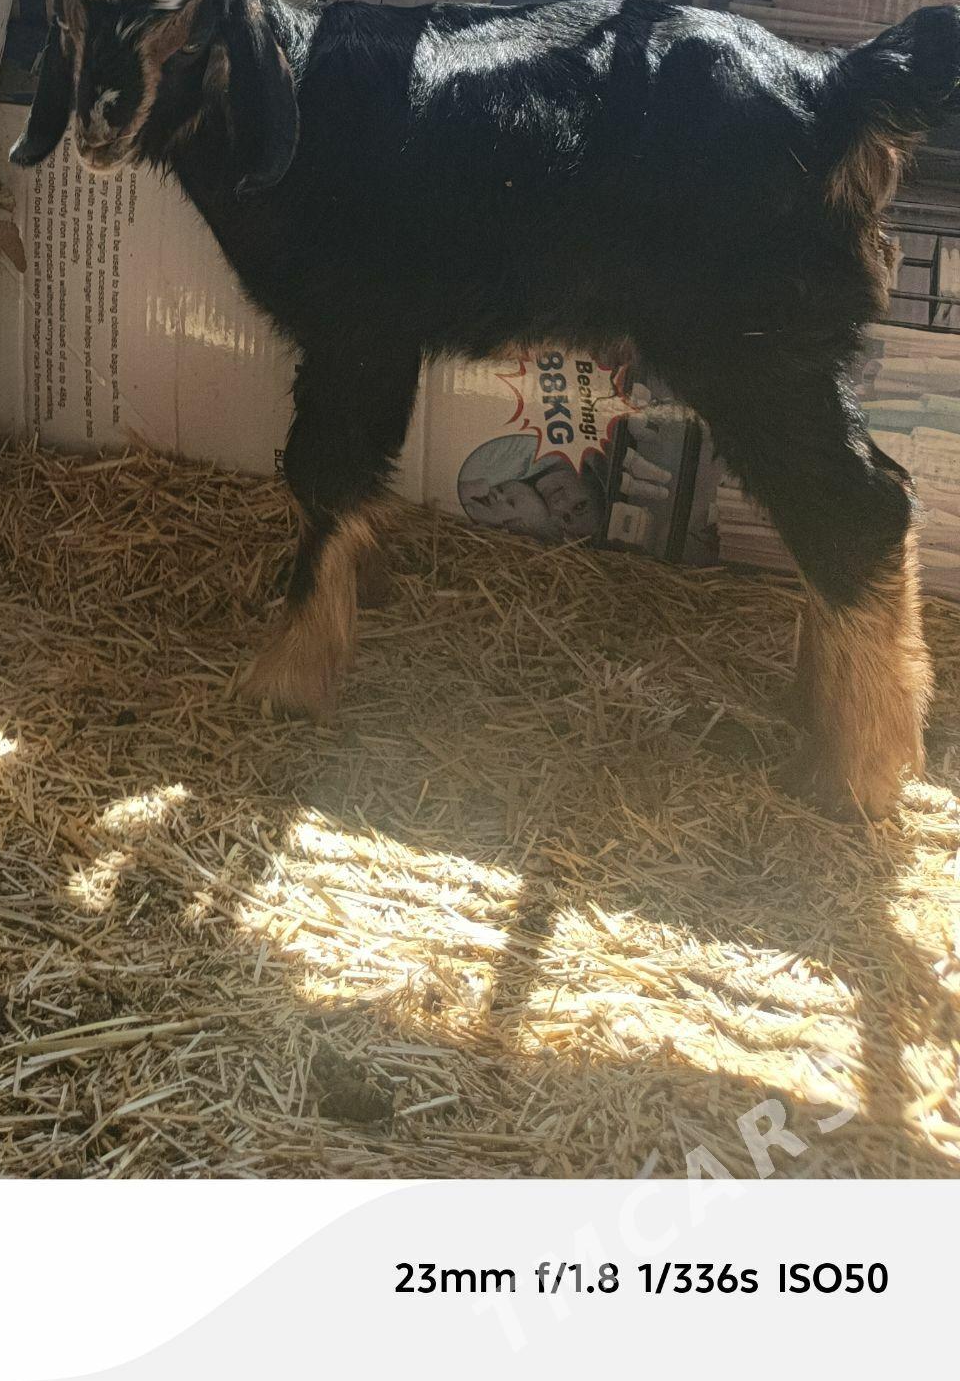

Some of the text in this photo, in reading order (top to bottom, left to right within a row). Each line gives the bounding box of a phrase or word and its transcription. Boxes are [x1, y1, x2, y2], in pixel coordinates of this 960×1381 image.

[62, 137, 72, 163] Made
[47, 171, 57, 205] clothes
[61, 165, 71, 188] from
[74, 186, 82, 212] items
[87, 186, 96, 208] with
[100, 180, 109, 197] any
[127, 172, 138, 227] excellence:
[34, 196, 43, 215] foot
[47, 206, 55, 216] is
[59, 189, 69, 219] sturdy
[87, 209, 94, 222] an
[100, 198, 110, 224] other
[46, 217, 55, 240] more
[59, 220, 69, 239] iron
[113, 219, 121, 238] can
[34, 240, 42, 260] that
[59, 240, 68, 259] that
[86, 223, 95, 269] additional
[98, 226, 108, 264] hanging
[112, 239, 122, 253] be
[45, 241, 55, 282] practical
[59, 259, 67, 278] can
[112, 254, 121, 278] used
[33, 277, 41, 300] keep
[84, 270, 94, 304] hanger
[111, 278, 120, 289] to
[34, 300, 42, 317] the
[46, 283, 54, 317] without
[59, 279, 68, 322] withstand
[110, 290, 120, 314] hang
[85, 305, 93, 324] that
[33, 317, 42, 349] hanger
[44, 317, 54, 358] worrying
[59, 323, 67, 348] loads
[83, 324, 93, 349] helps
[34, 350, 42, 372] rack
[59, 350, 68, 361] of
[83, 350, 91, 368] you
[46, 357, 54, 384] about
[59, 374, 67, 386] to
[83, 368, 92, 384] put
[83, 384, 93, 408] bags
[536, 350, 575, 445] 88KG
[575, 359, 599, 442] Bearing:
[85, 420, 94, 439] hats
